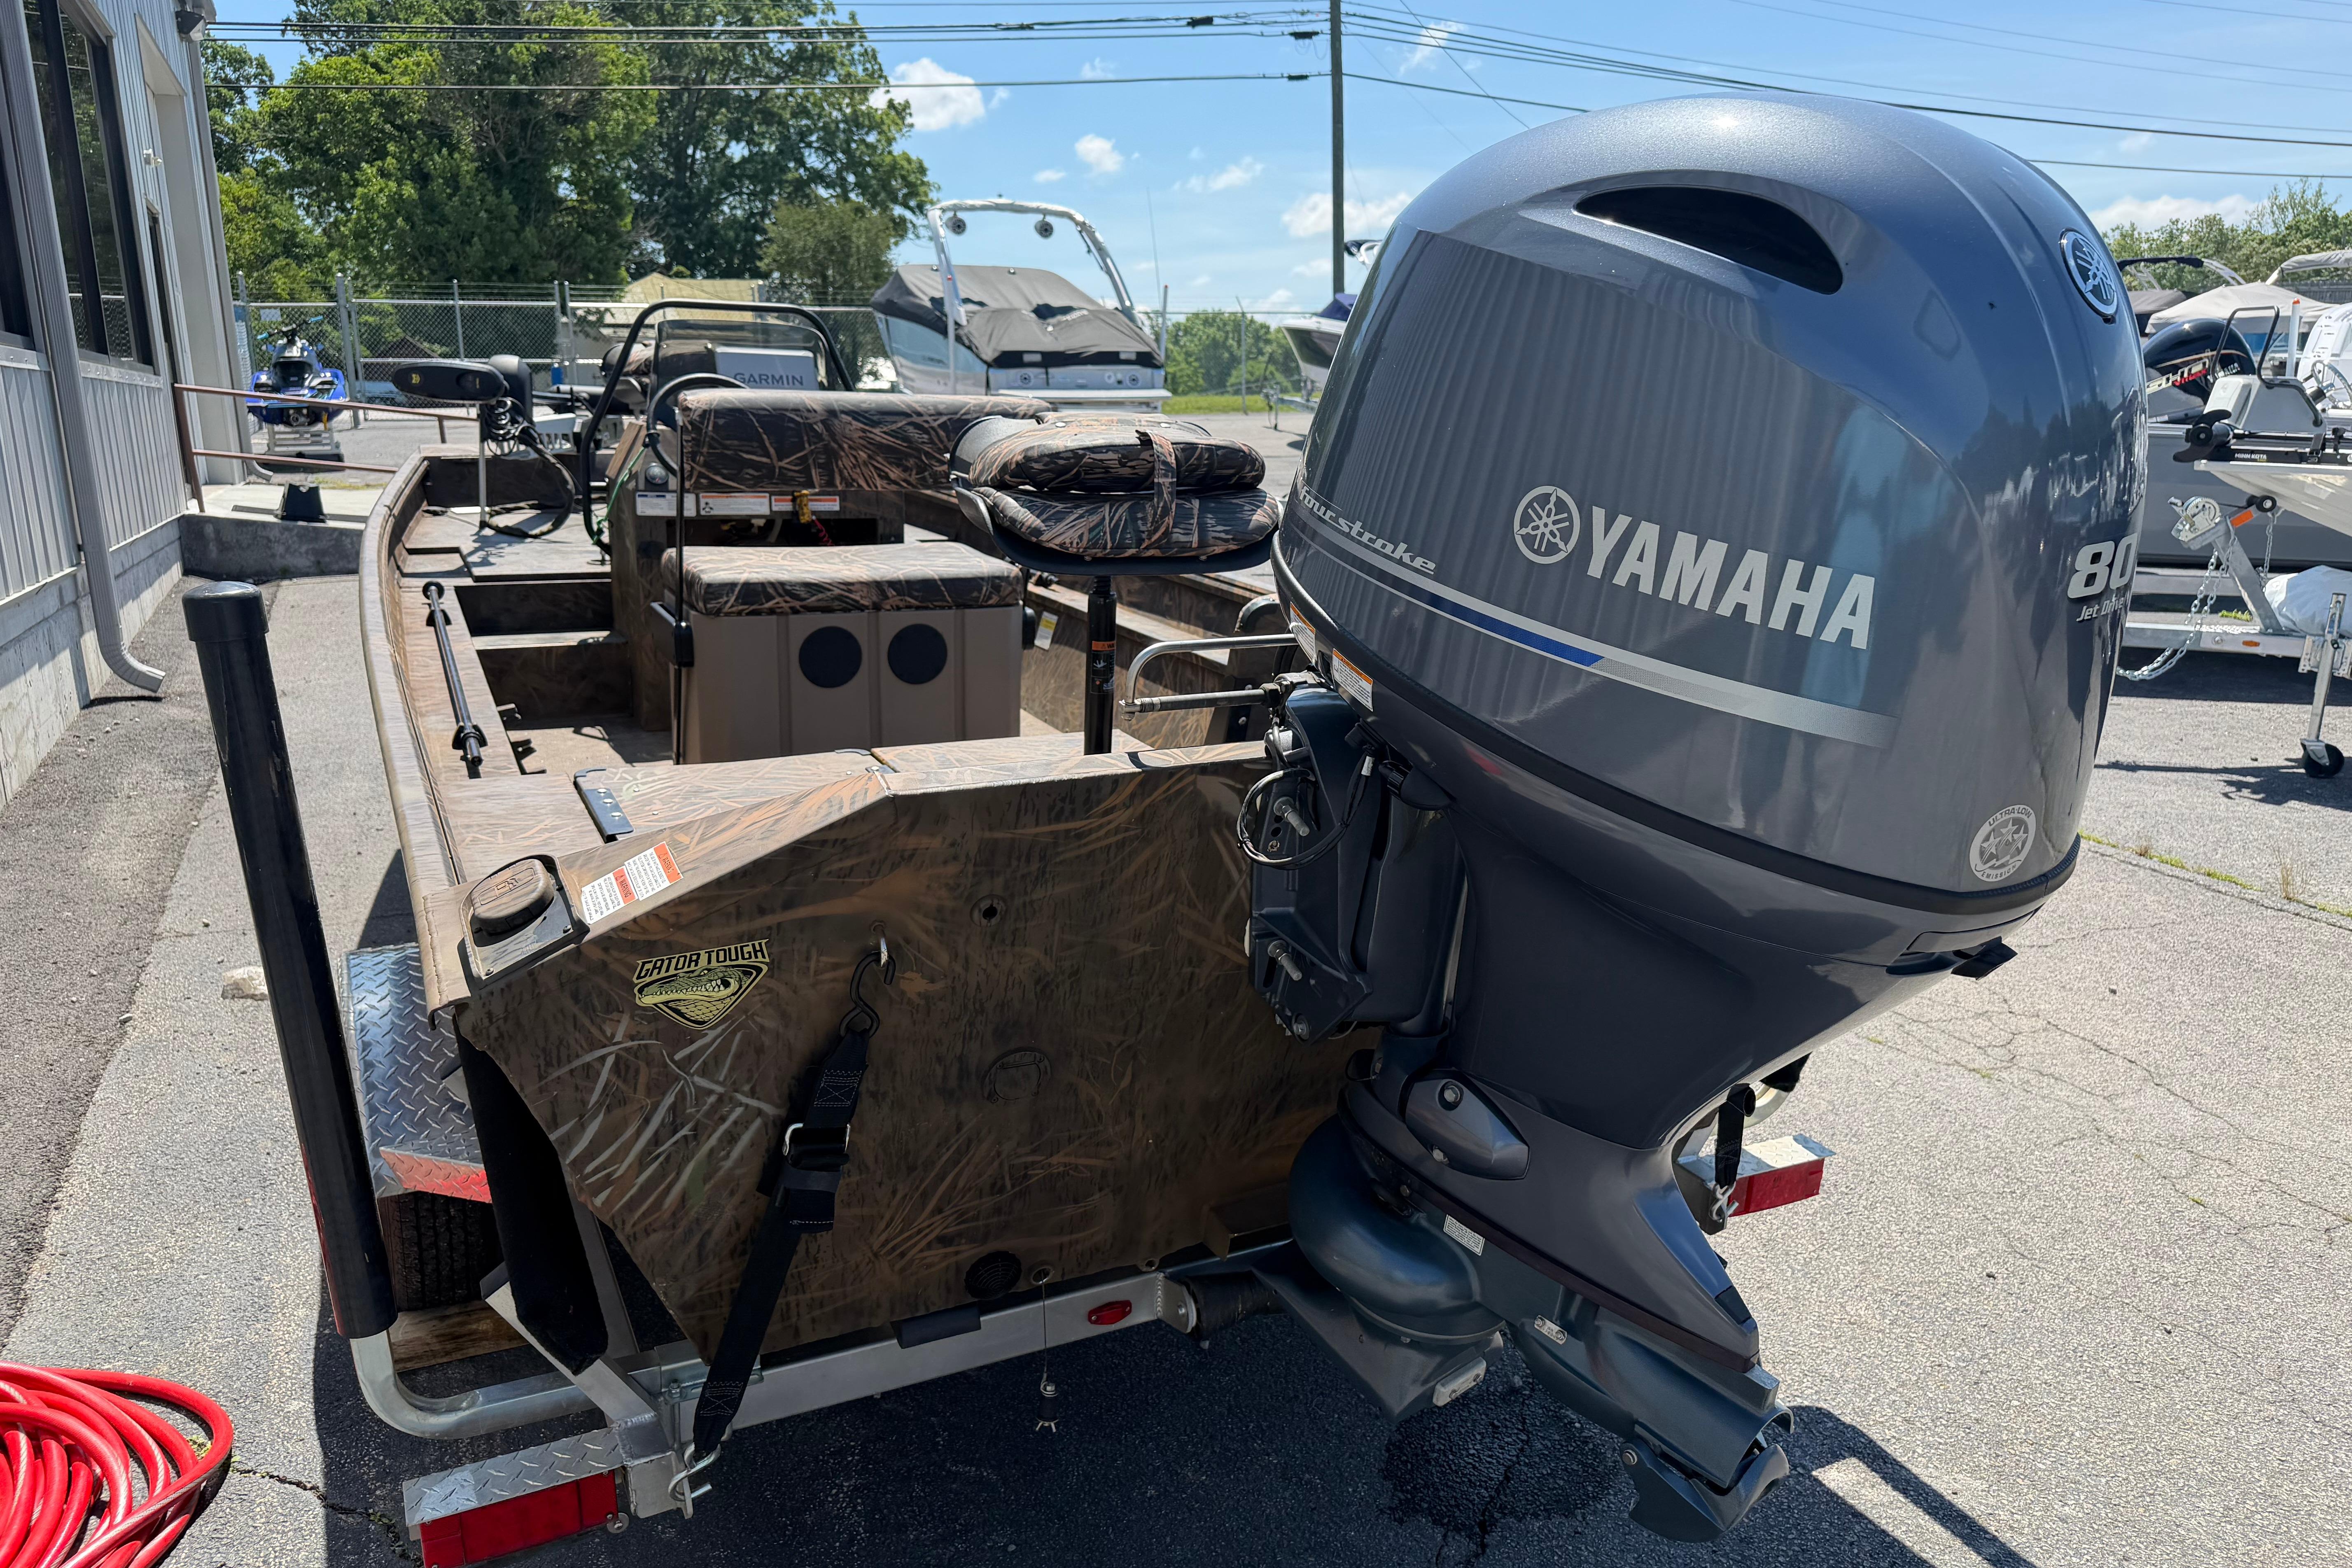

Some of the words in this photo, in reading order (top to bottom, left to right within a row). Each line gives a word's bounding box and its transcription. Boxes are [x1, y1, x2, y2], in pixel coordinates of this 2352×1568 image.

[734, 373, 803, 386] GARMIN
[1587, 506, 1875, 649] YAMAHA
[2067, 532, 2138, 598] 80
[2076, 604, 2099, 621] Jet
[2101, 597, 2124, 615] Drive
[1981, 863, 2016, 879] EMISSION
[636, 952, 701, 980] GATOR
[705, 942, 766, 965] TOUGH
